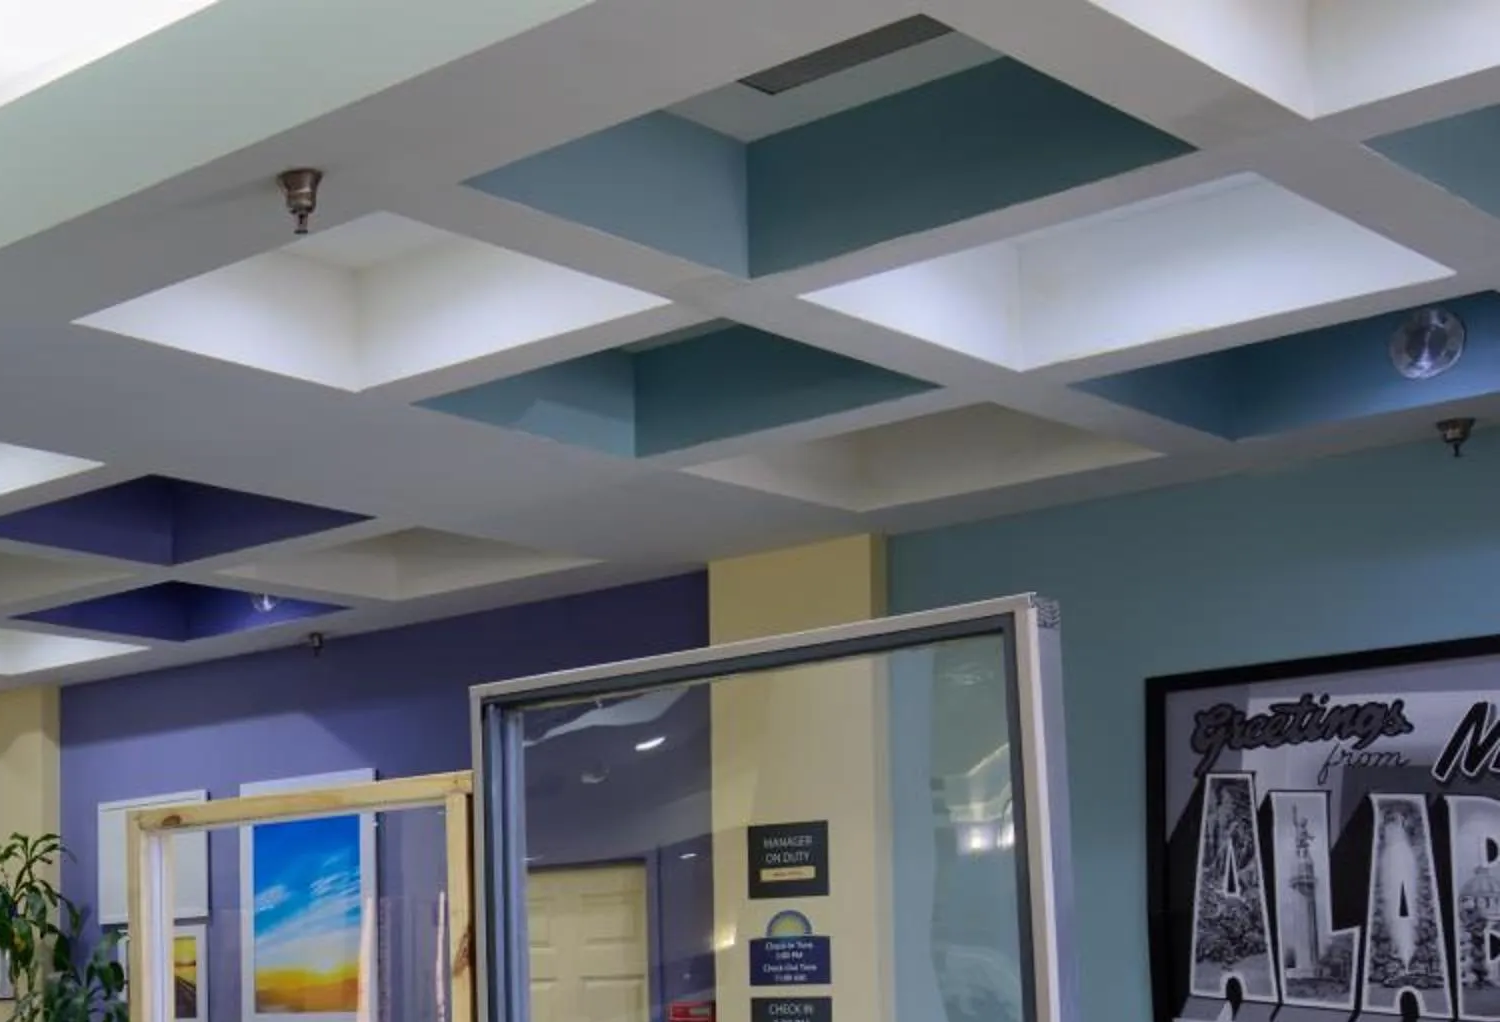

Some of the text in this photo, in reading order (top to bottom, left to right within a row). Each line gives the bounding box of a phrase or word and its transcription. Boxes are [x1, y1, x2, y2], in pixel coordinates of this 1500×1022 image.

[1191, 693, 1414, 778] Greetings
[1317, 742, 1411, 785] from
[763, 835, 813, 849] MANAGER
[765, 850, 810, 865] ON DUTY
[768, 1003, 815, 1016] CHECK IN
